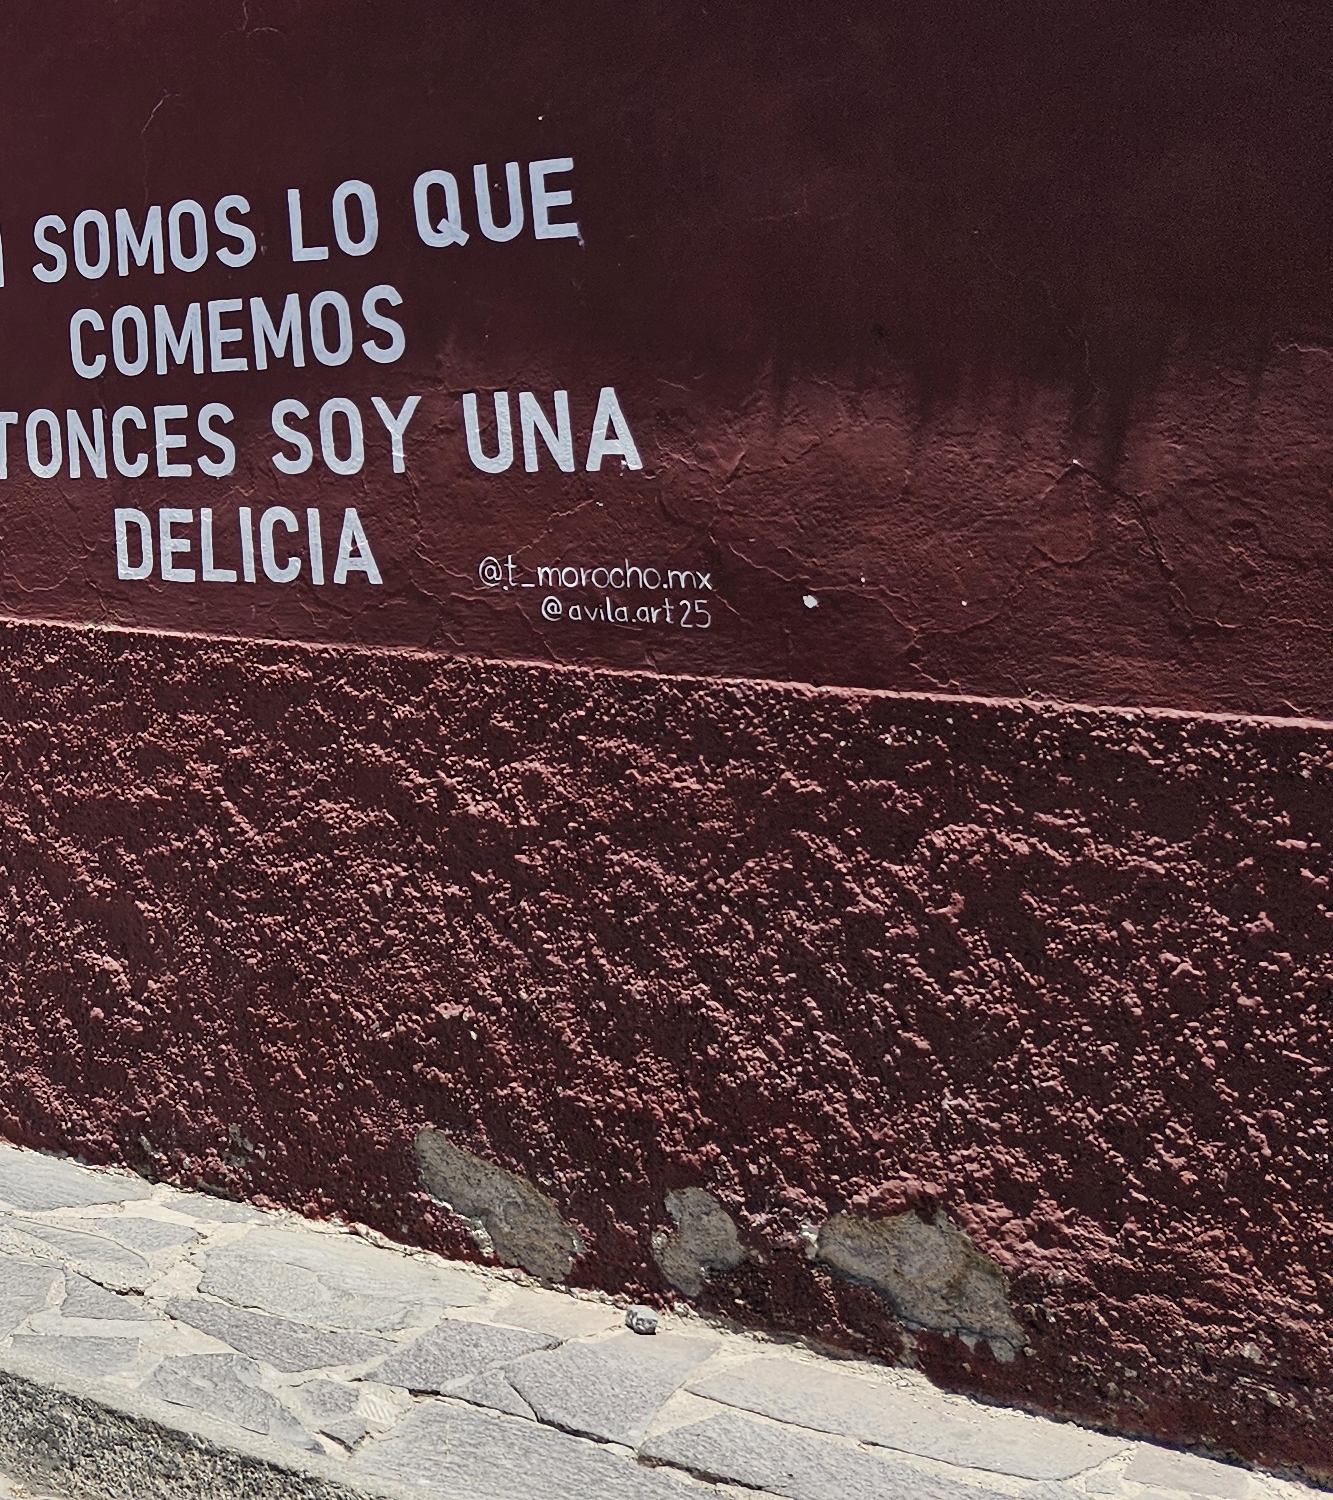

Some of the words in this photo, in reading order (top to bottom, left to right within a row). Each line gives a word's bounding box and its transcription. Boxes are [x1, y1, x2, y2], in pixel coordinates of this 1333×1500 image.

[32, 194, 257, 284] SOMOS
[287, 180, 379, 262] LO
[413, 157, 581, 248] QUE
[69, 284, 406, 378] COMEMOS
[271, 395, 422, 476] SOY
[462, 386, 644, 474] UNA
[115, 506, 384, 586] DELICIA
